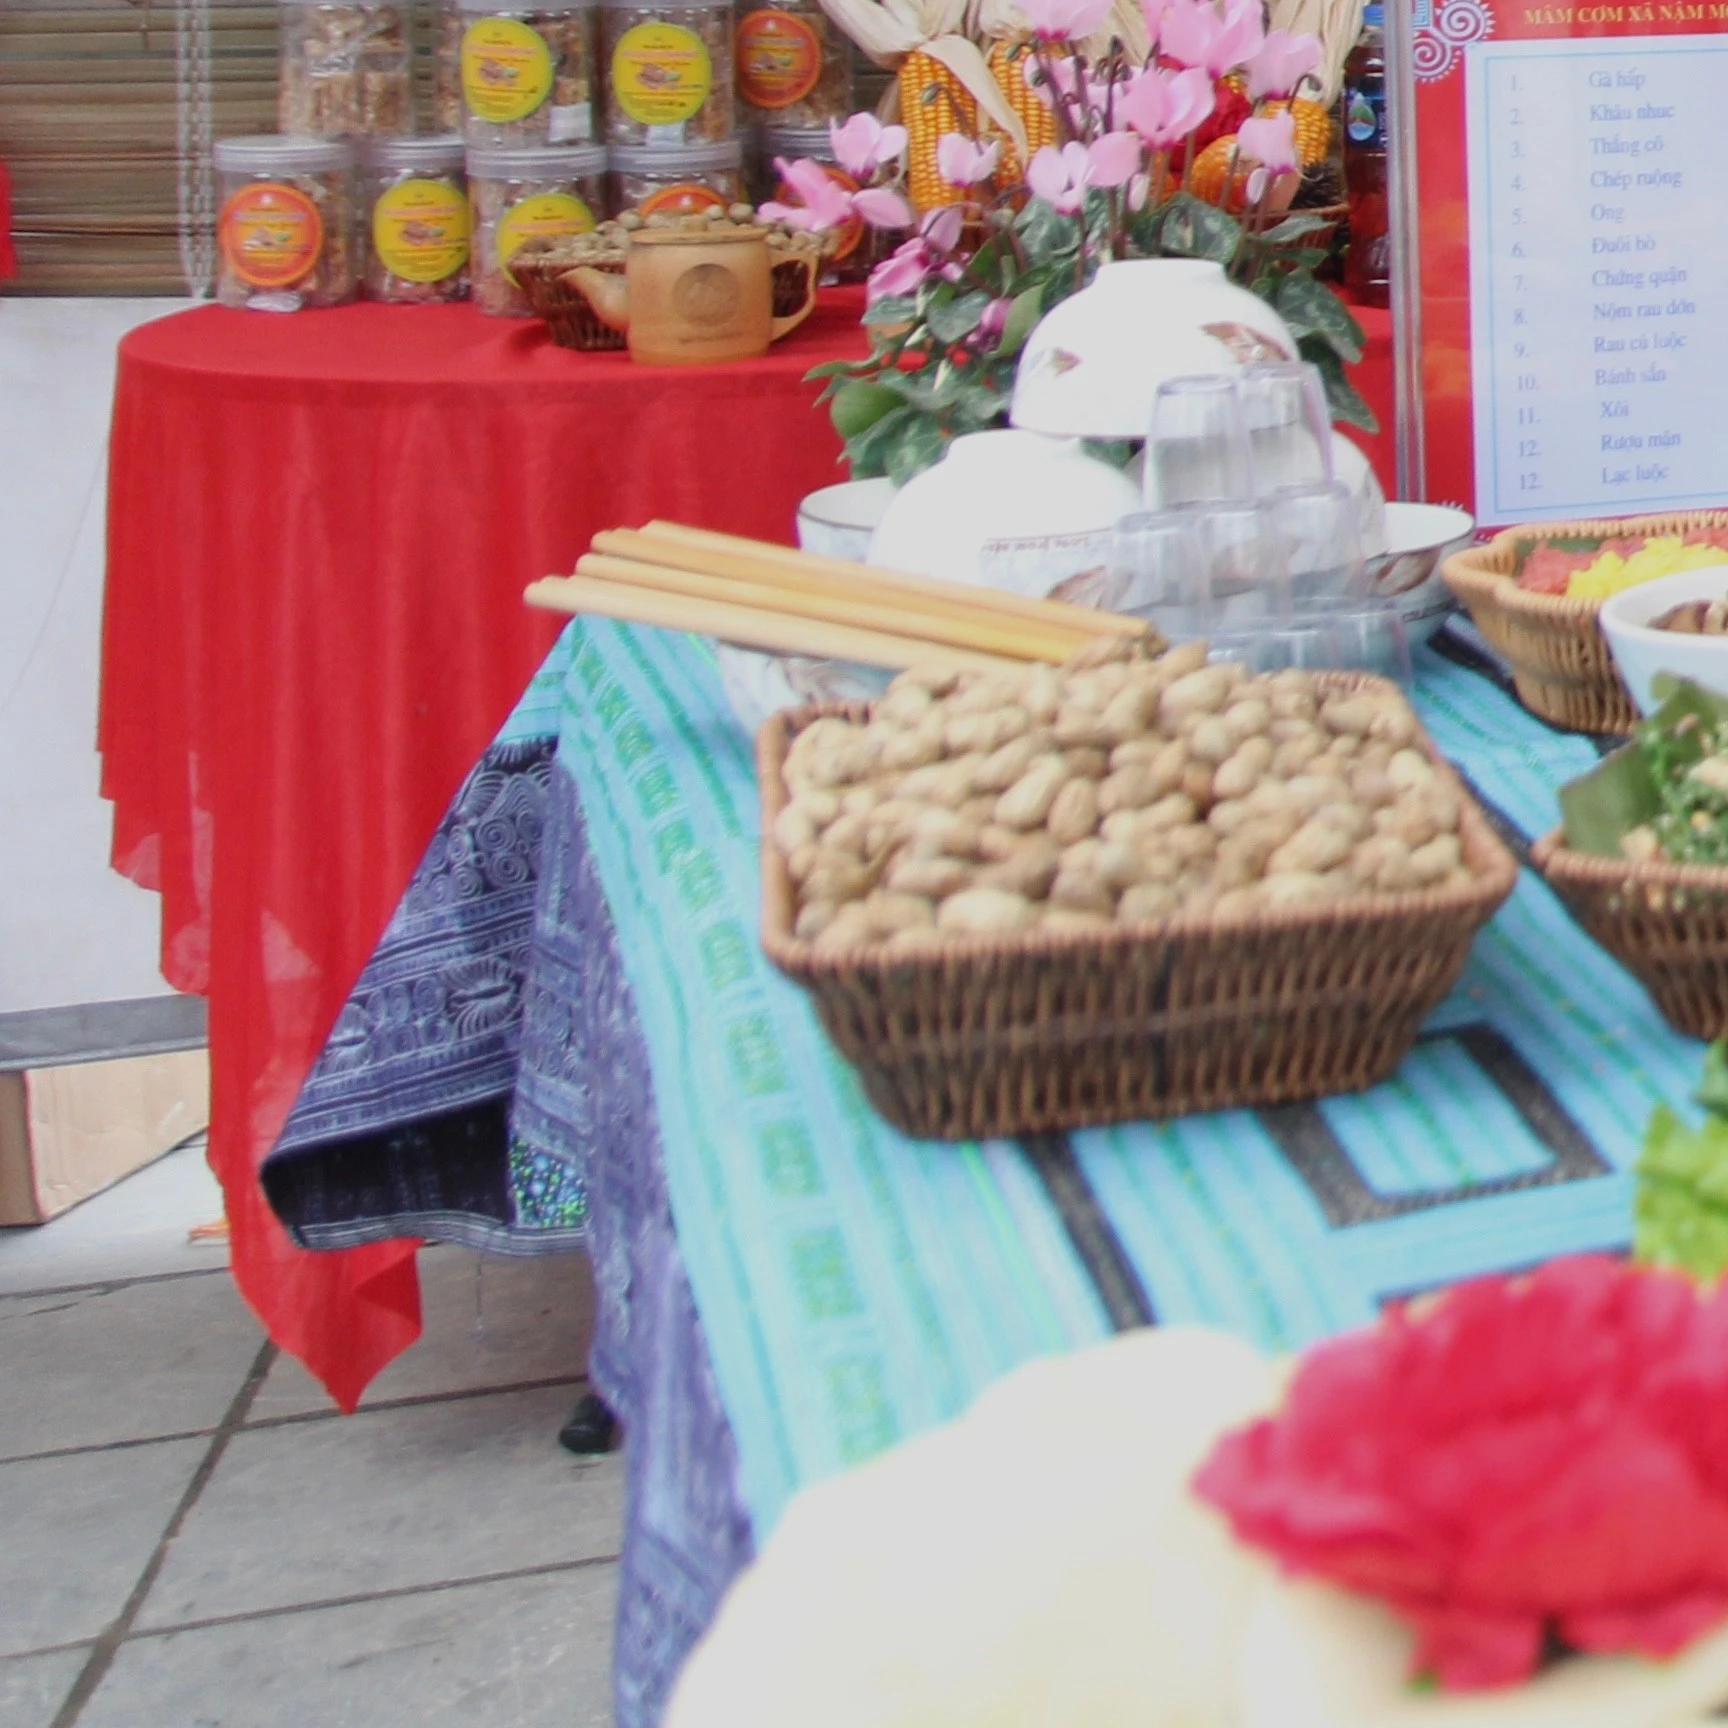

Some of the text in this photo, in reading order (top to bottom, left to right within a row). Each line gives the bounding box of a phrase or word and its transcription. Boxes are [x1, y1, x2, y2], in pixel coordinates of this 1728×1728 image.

[1523, 4, 1572, 25] MÂM
[1577, 3, 1624, 23] CƠM
[1628, 2, 1655, 22] XÃ
[1659, 0, 1704, 24] NẬM
